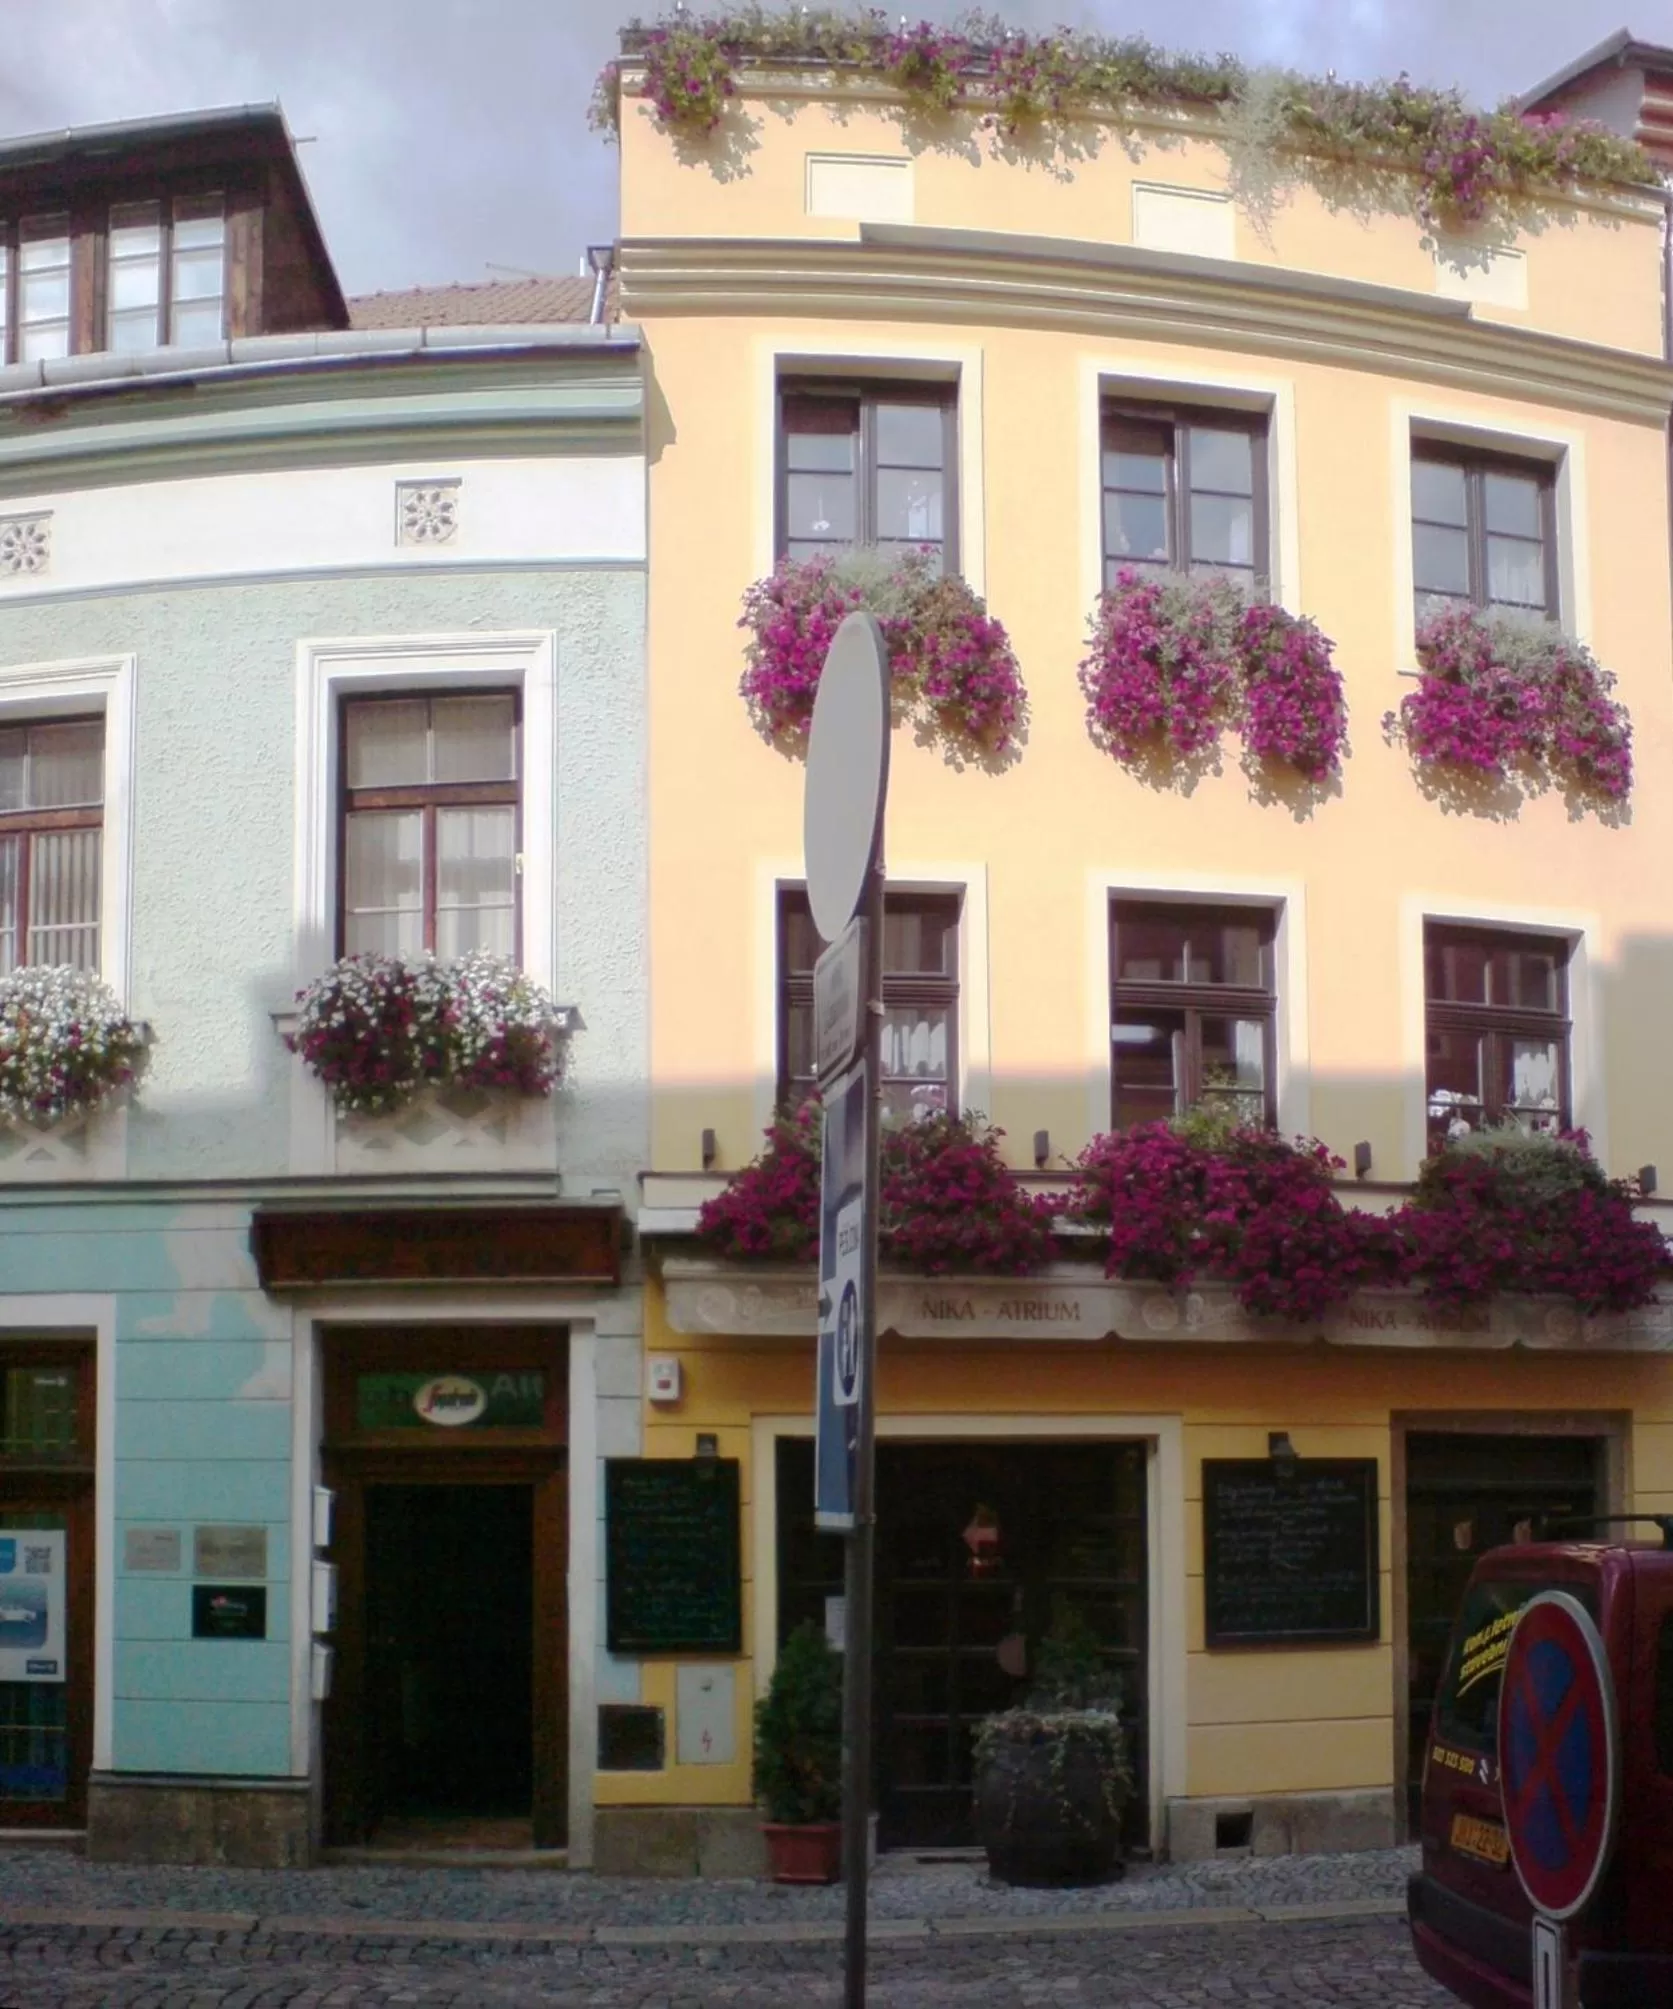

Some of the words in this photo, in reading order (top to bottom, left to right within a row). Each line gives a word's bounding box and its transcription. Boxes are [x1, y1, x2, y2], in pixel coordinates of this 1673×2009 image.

[921, 1298, 976, 1321] NIKA
[996, 1300, 1081, 1321] ATRIUM
[1347, 1308, 1397, 1329] NIKA
